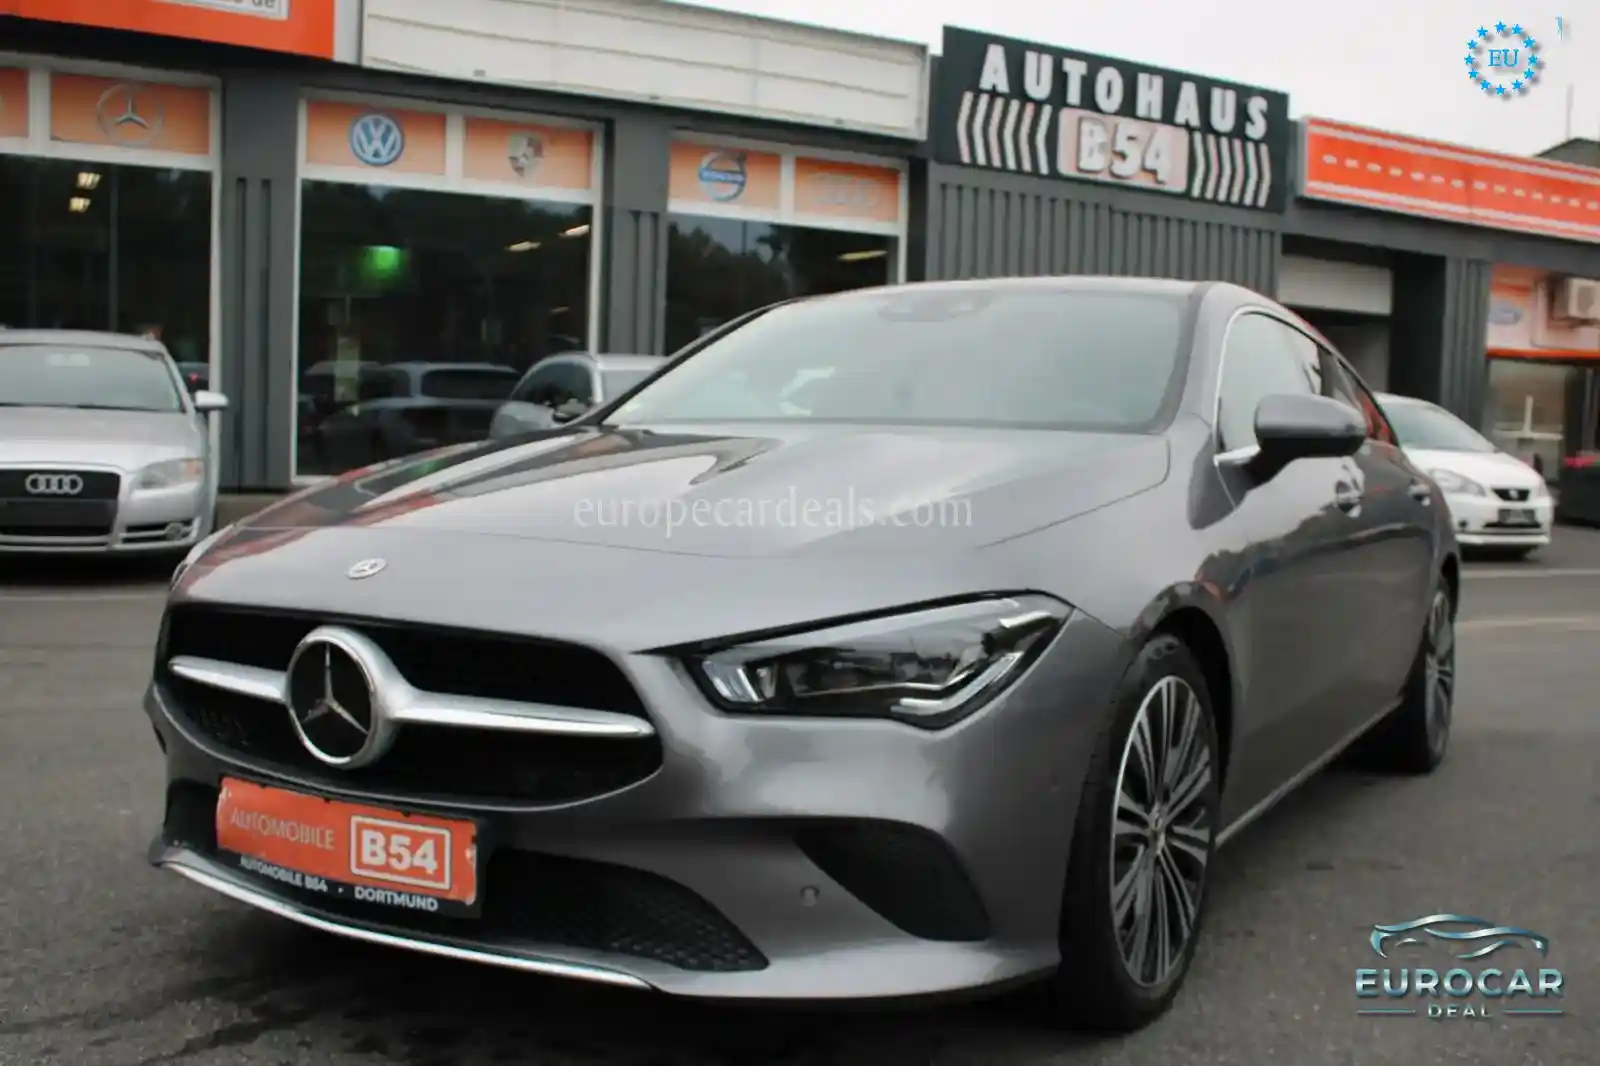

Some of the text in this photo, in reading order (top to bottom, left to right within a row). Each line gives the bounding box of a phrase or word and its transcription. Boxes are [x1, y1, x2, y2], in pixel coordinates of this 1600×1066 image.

[979, 43, 1269, 141] AUTOHAUS
[1076, 115, 1171, 185] B54
[229, 808, 336, 850] AUTOMOBILE
[361, 829, 438, 876] B54
[353, 886, 439, 912] DORTMUND
